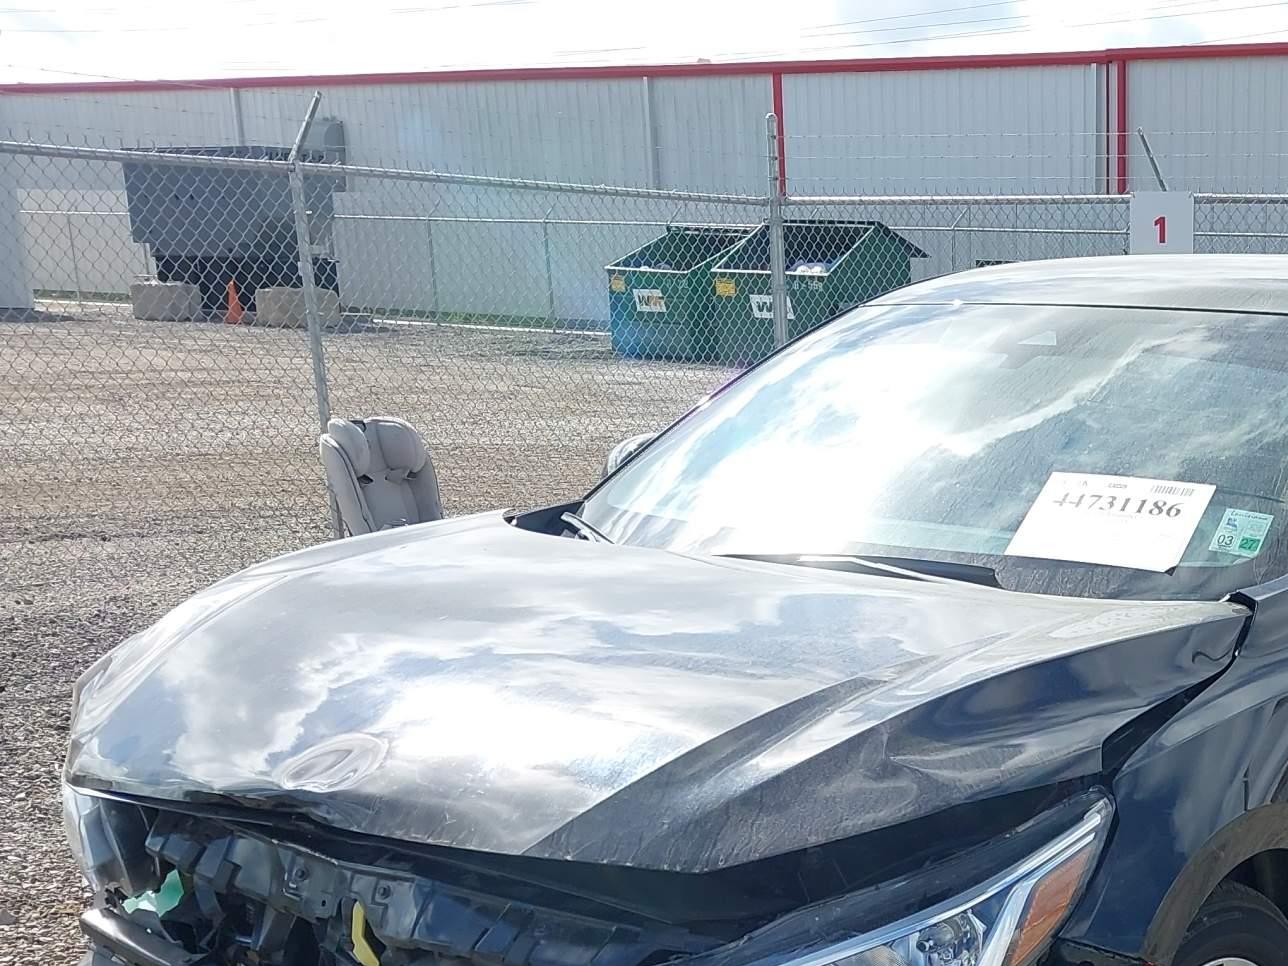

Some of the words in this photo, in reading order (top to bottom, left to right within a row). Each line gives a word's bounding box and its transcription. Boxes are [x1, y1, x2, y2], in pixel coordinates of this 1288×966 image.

[1153, 215, 1166, 244] 1
[1052, 491, 1185, 518] 44731186
[1217, 534, 1234, 546] 03
[1240, 538, 1256, 550] 27
